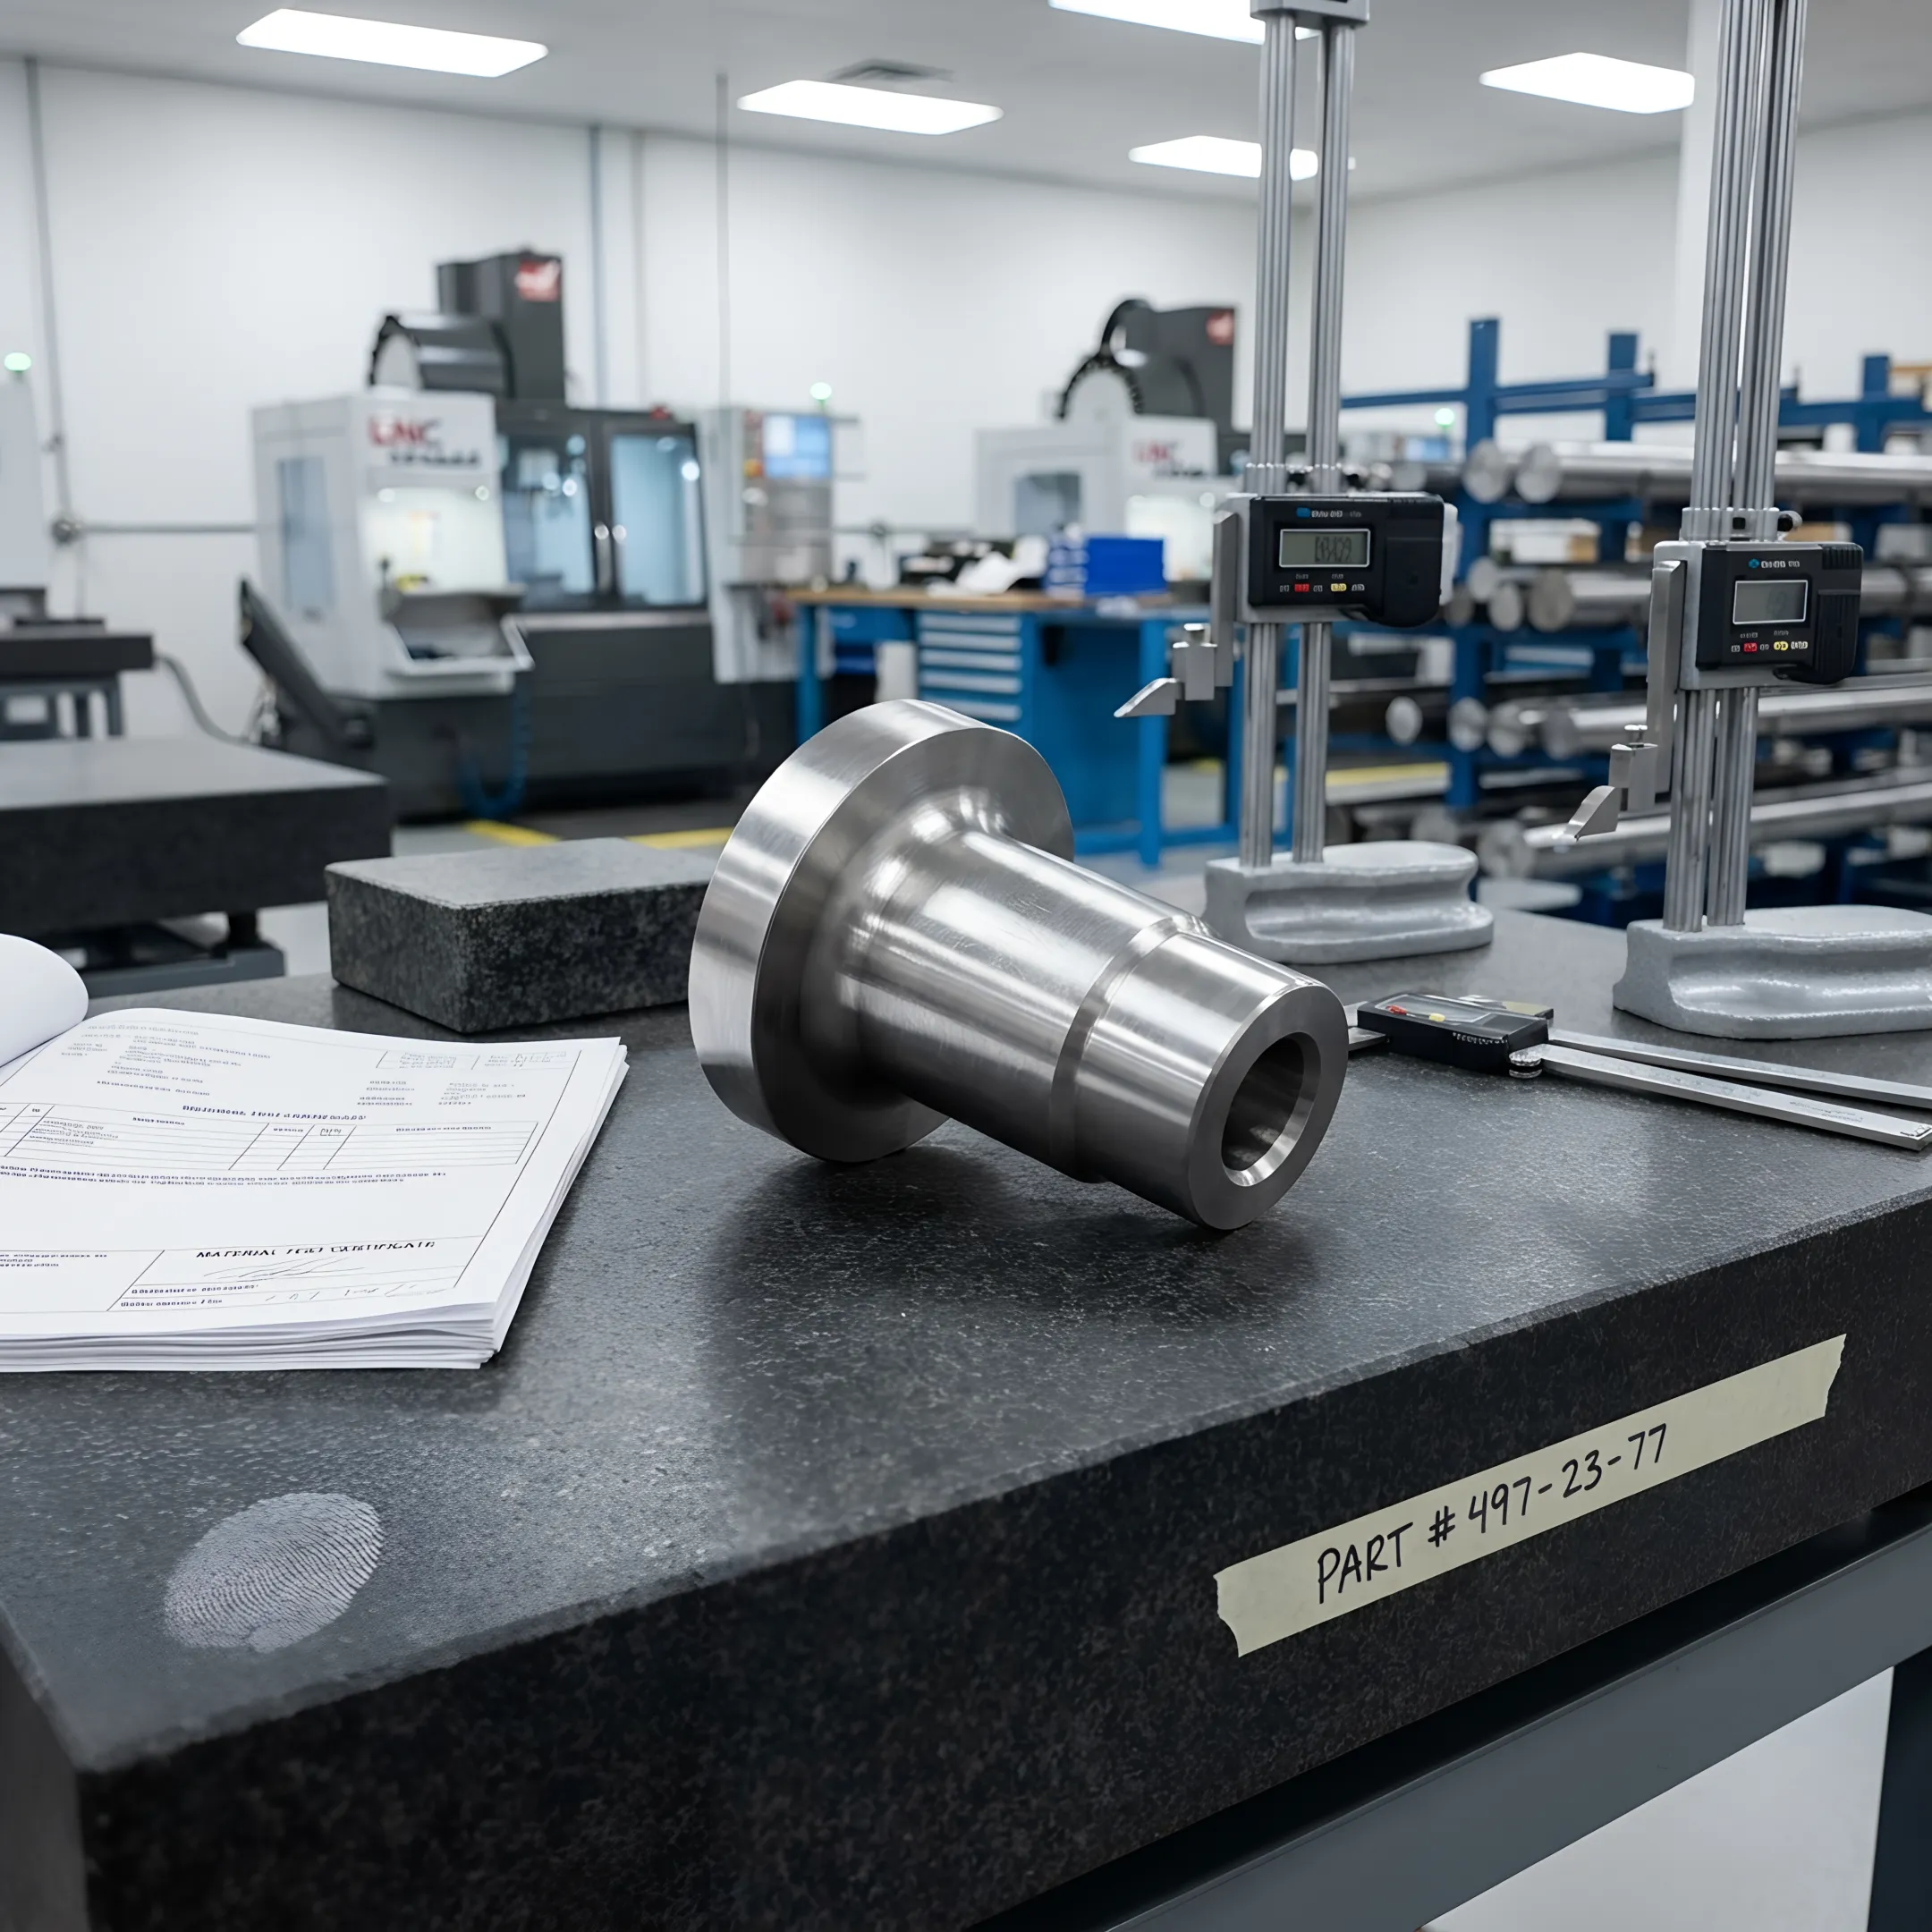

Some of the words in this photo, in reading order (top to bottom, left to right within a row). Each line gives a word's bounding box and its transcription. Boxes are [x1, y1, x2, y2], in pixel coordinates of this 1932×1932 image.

[1317, 1522, 1413, 1605] PART
[1428, 1505, 1456, 1548] #
[1468, 1422, 1667, 1534] 497-23-77
